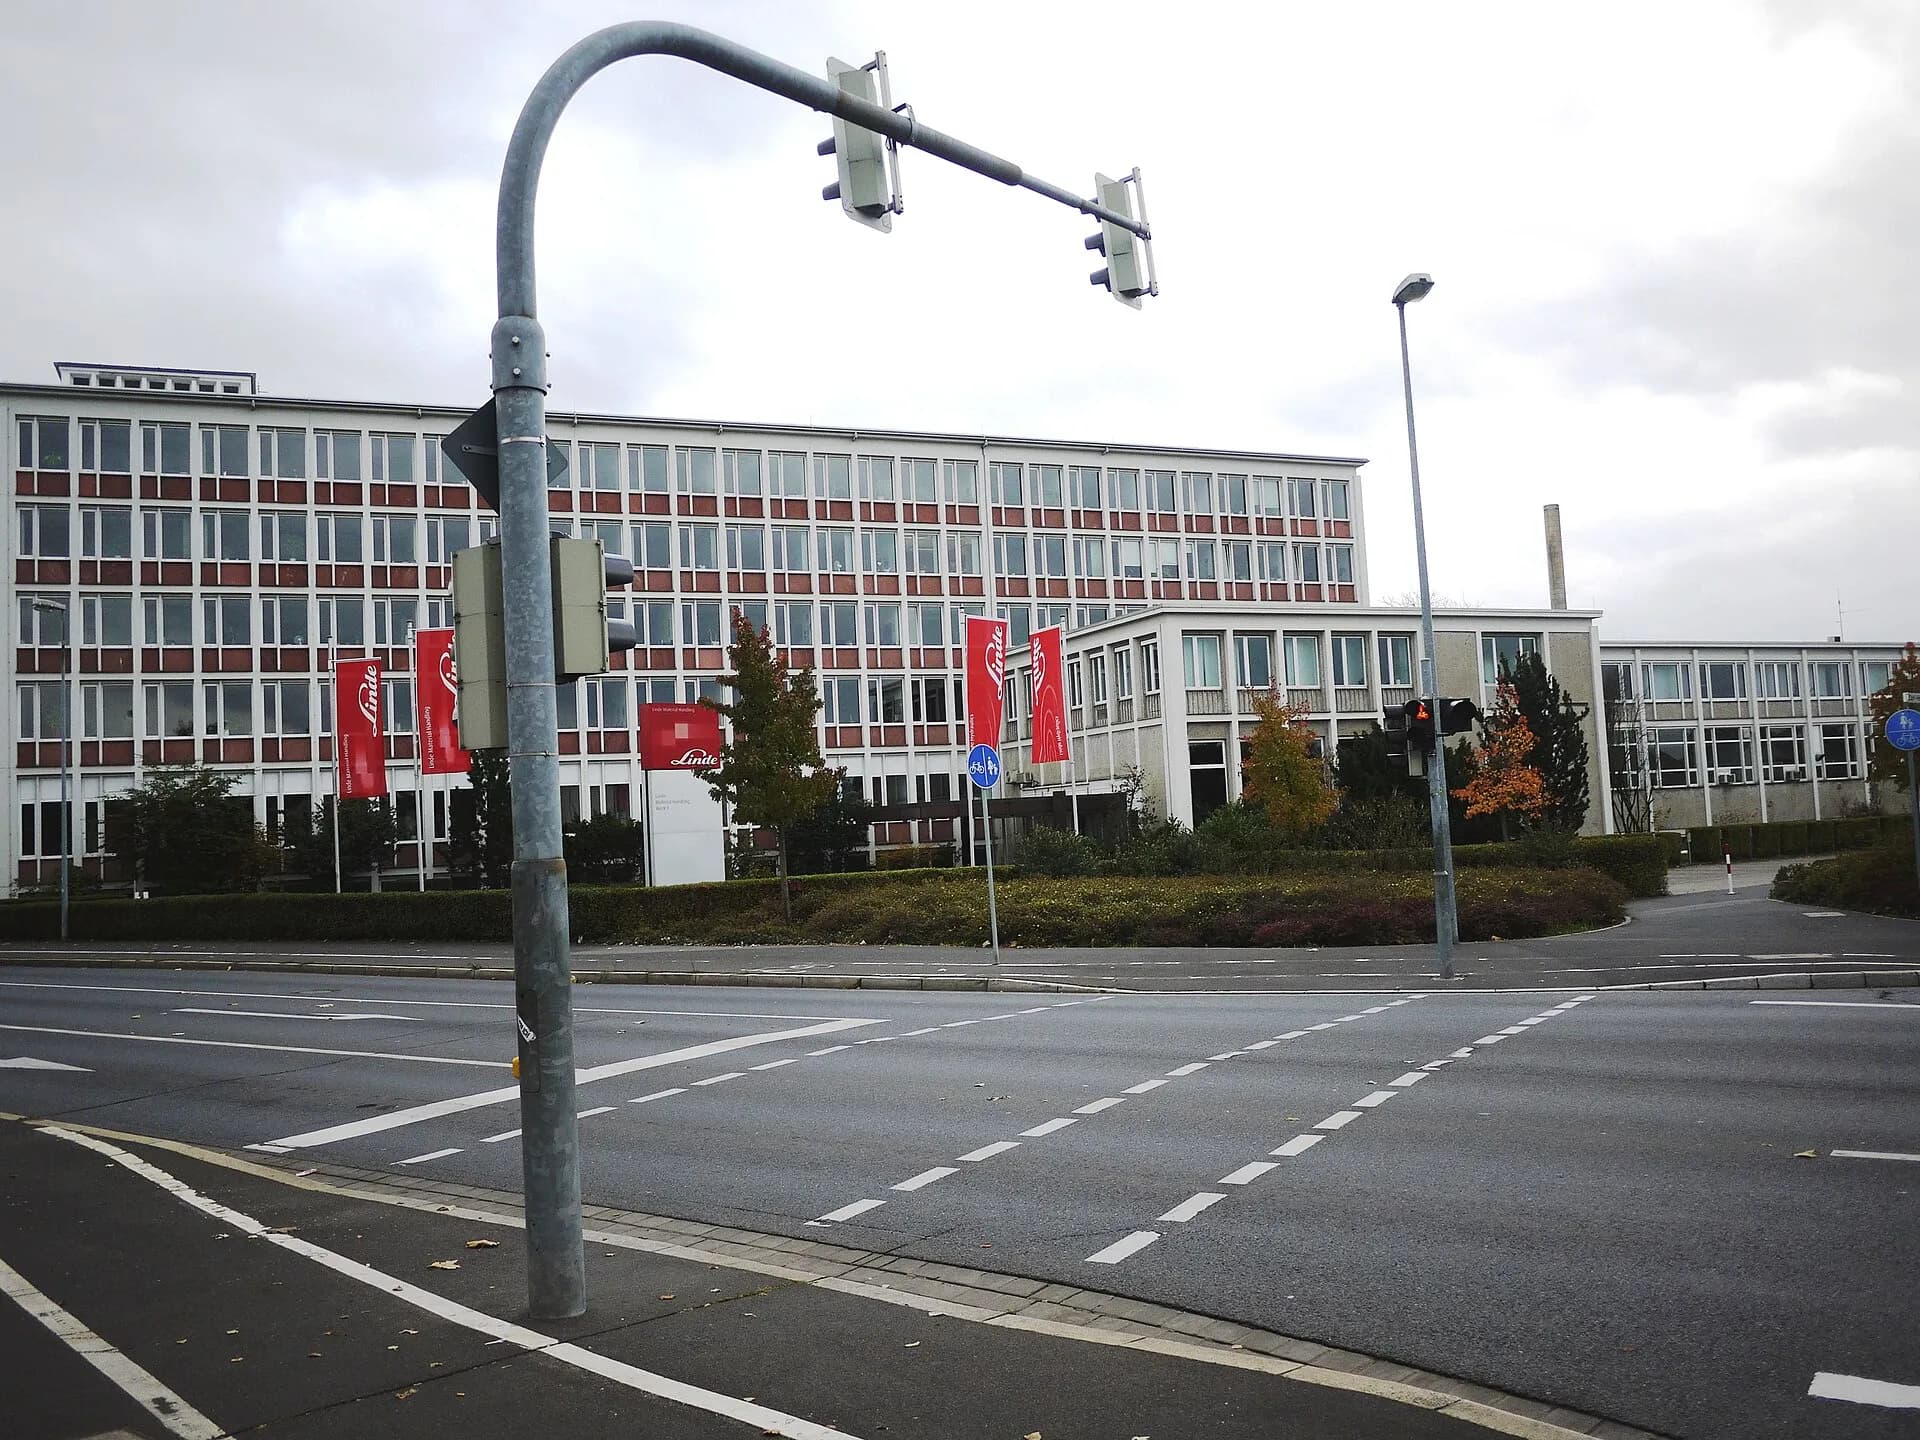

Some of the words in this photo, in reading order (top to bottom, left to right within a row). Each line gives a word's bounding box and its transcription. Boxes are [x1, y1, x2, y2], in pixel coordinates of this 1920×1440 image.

[985, 625, 1003, 701] Linde
[358, 664, 378, 738] Linde
[427, 754, 435, 769] Linde
[671, 748, 718, 765] Linde
